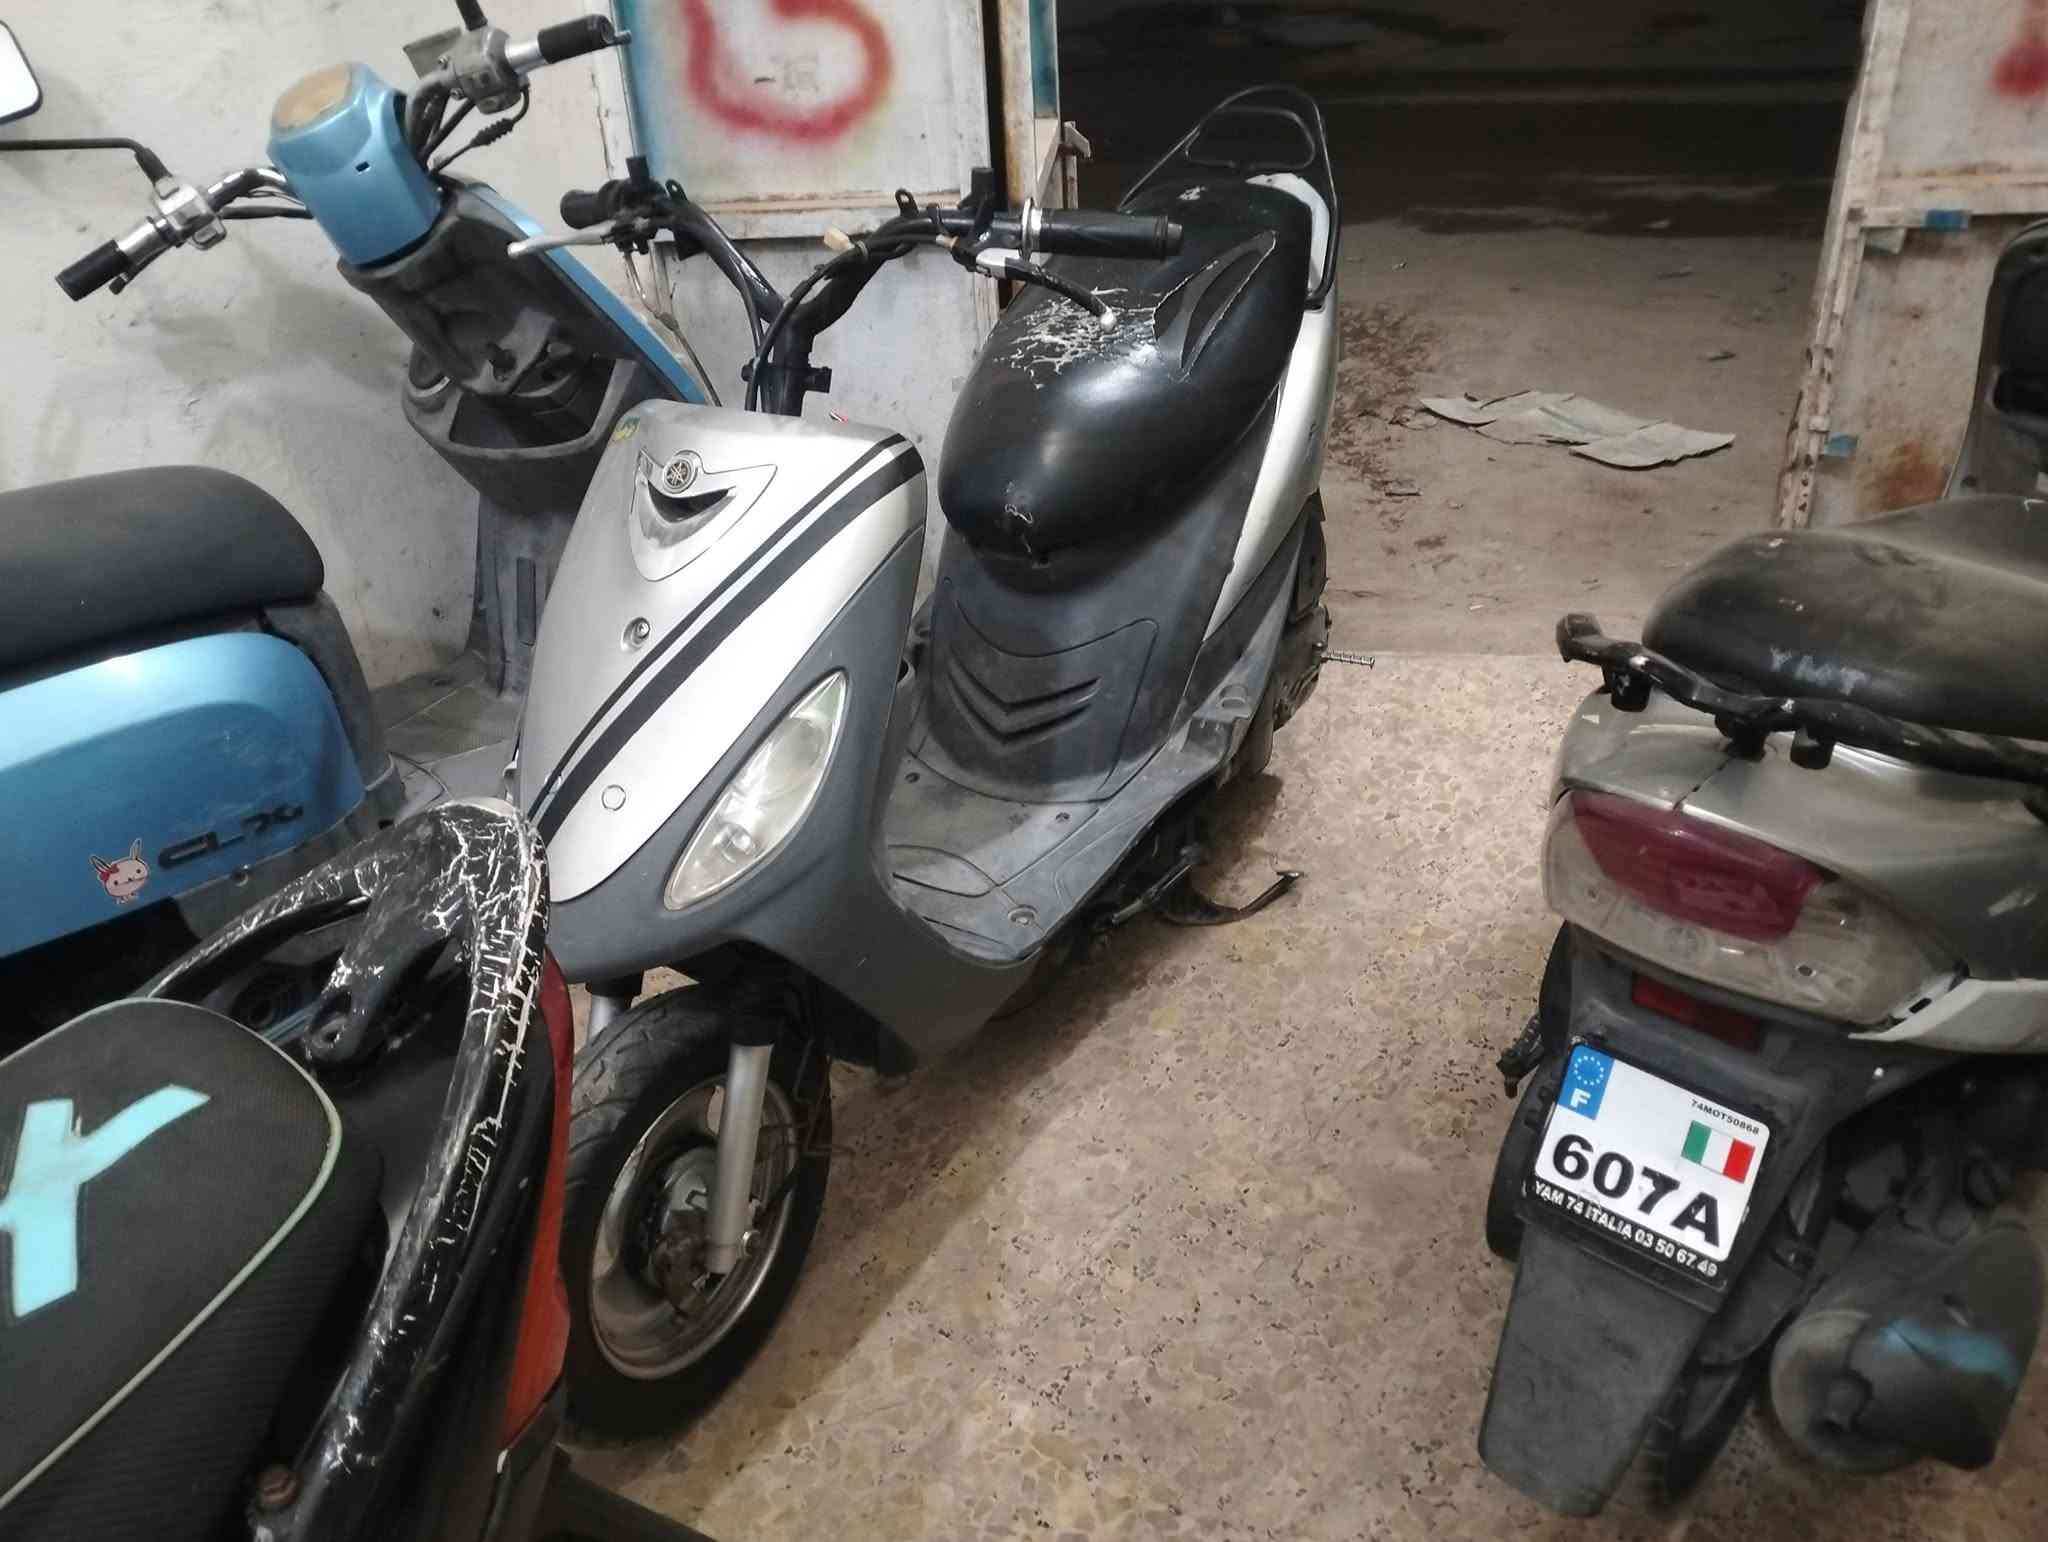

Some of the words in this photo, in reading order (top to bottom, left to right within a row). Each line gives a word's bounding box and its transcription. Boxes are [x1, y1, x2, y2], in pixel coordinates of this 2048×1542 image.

[1569, 1087, 1591, 1109] F
[1534, 1180, 1565, 1206] YAM
[1566, 1193, 1585, 1214] 74
[1584, 1204, 1633, 1240] ITALIA
[1634, 1228, 1653, 1249] 03
[1655, 1237, 1676, 1259] 50
[1552, 1133, 1720, 1248] 607A
